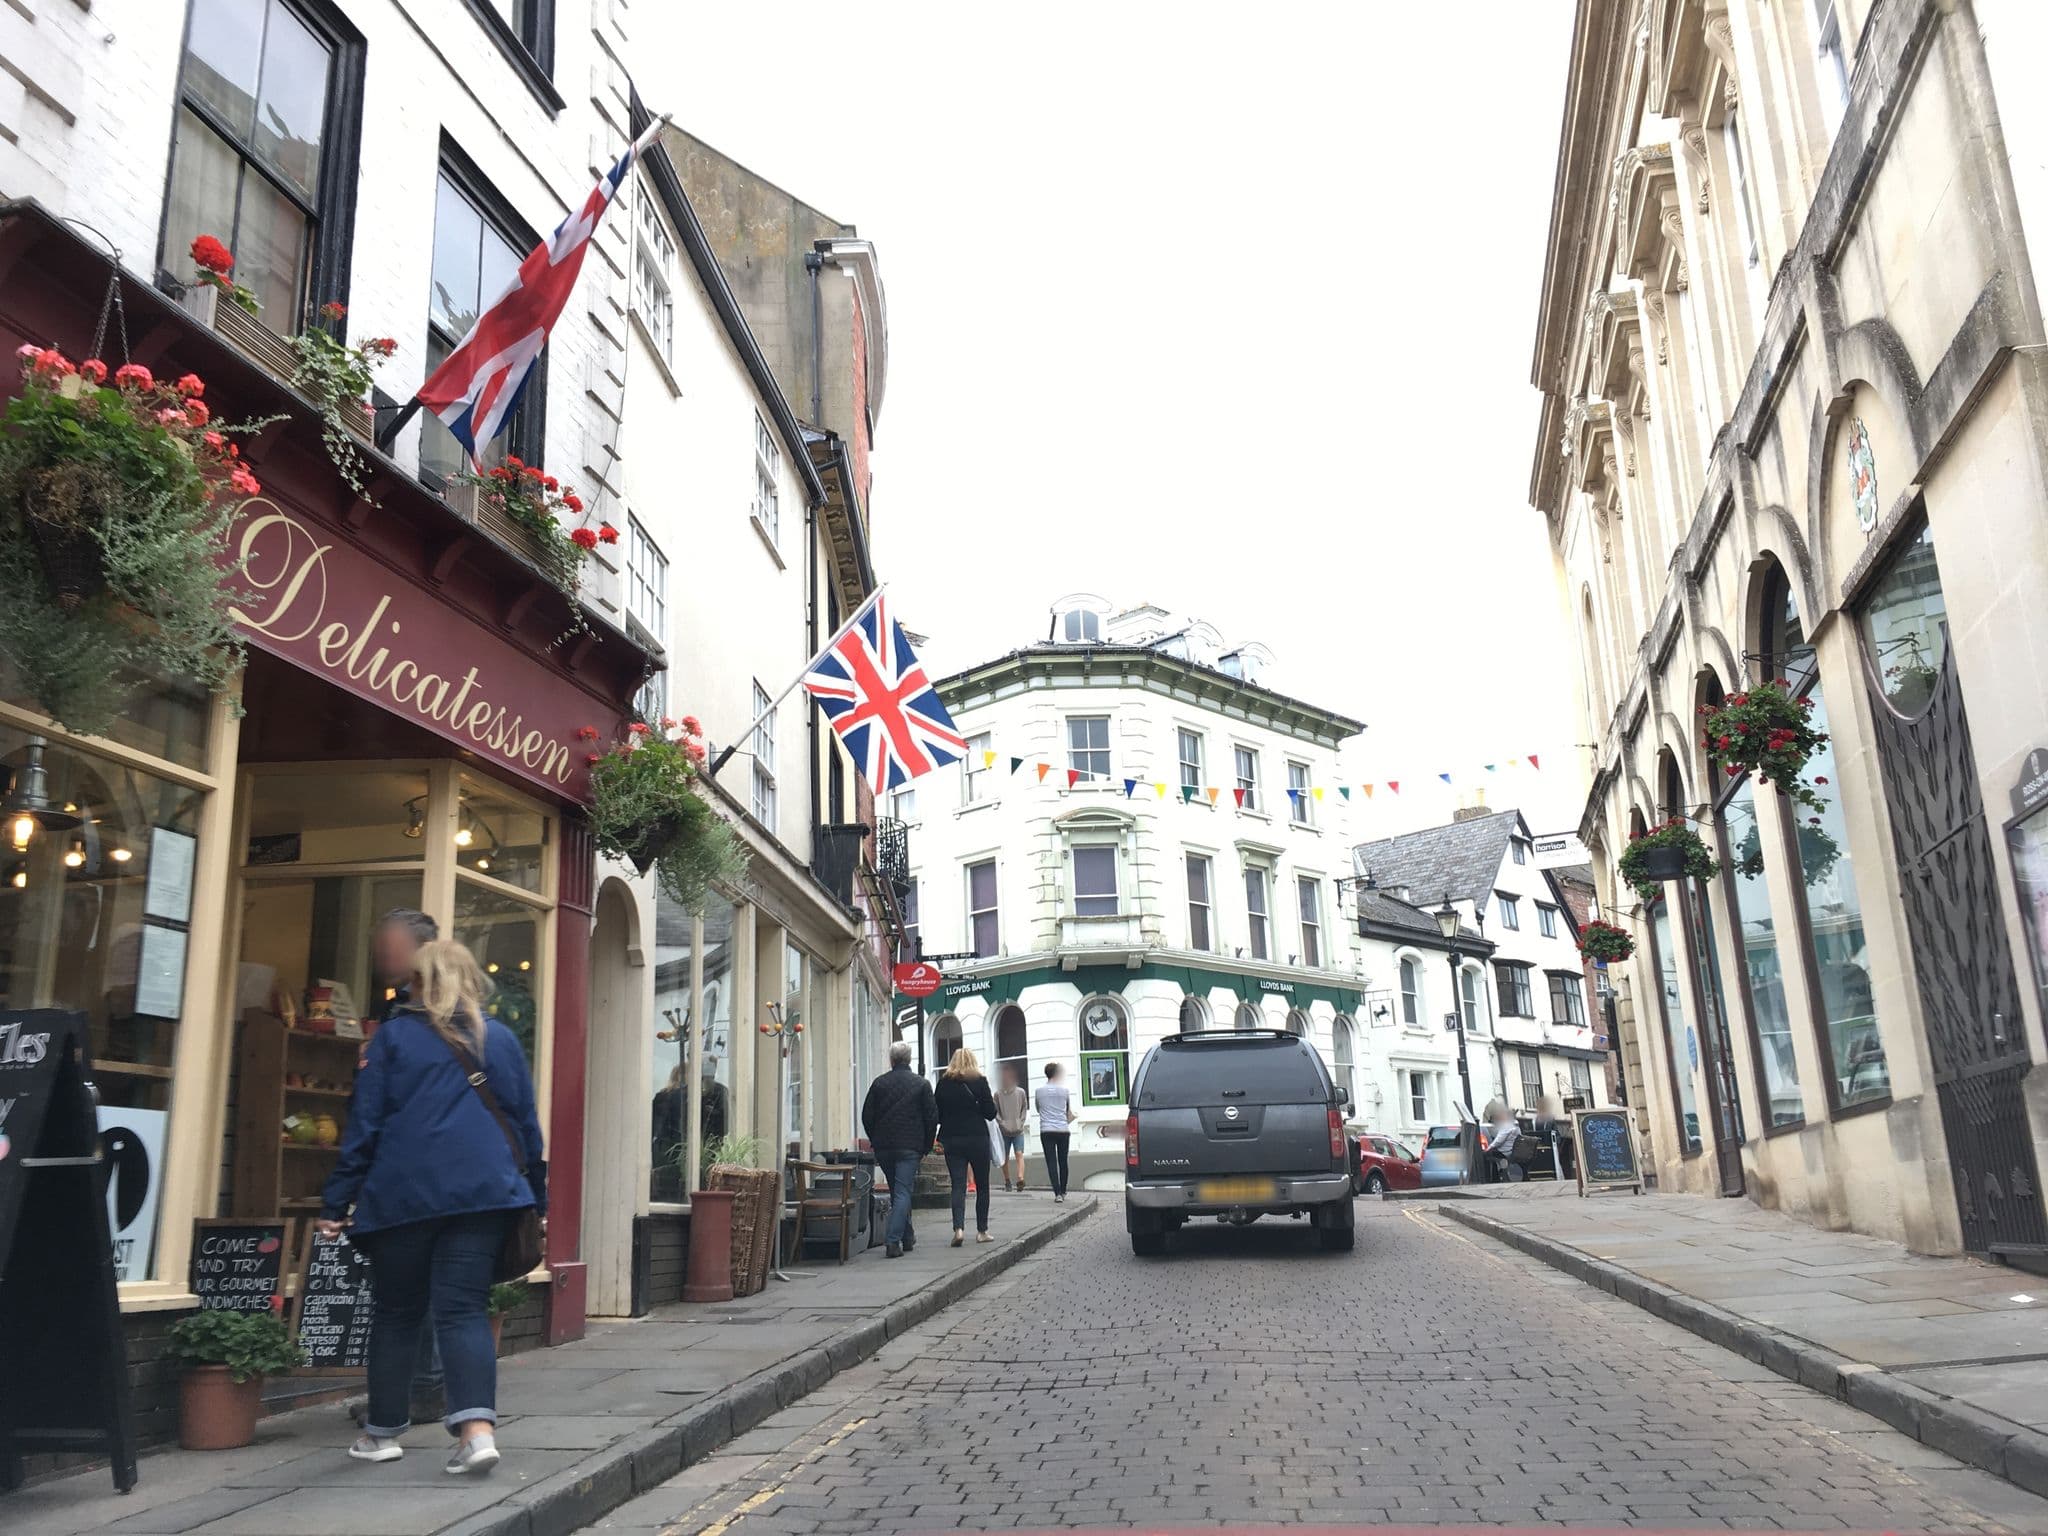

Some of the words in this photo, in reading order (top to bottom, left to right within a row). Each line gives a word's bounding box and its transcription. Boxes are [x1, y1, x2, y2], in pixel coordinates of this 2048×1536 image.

[226, 497, 573, 784] Delicatessen
[1536, 843, 1566, 852] harrison
[946, 984, 970, 996] LLOYDS
[972, 980, 991, 990] BANK
[1260, 980, 1280, 990] LLOYDS
[1280, 983, 1295, 992] BANK
[202, 1236, 259, 1254] COME
[319, 1247, 341, 1261] Hot
[196, 1258, 225, 1273] AND
[232, 1258, 266, 1273] TRY
[309, 1261, 349, 1276] Drinks
[219, 1277, 279, 1291] GOURMET
